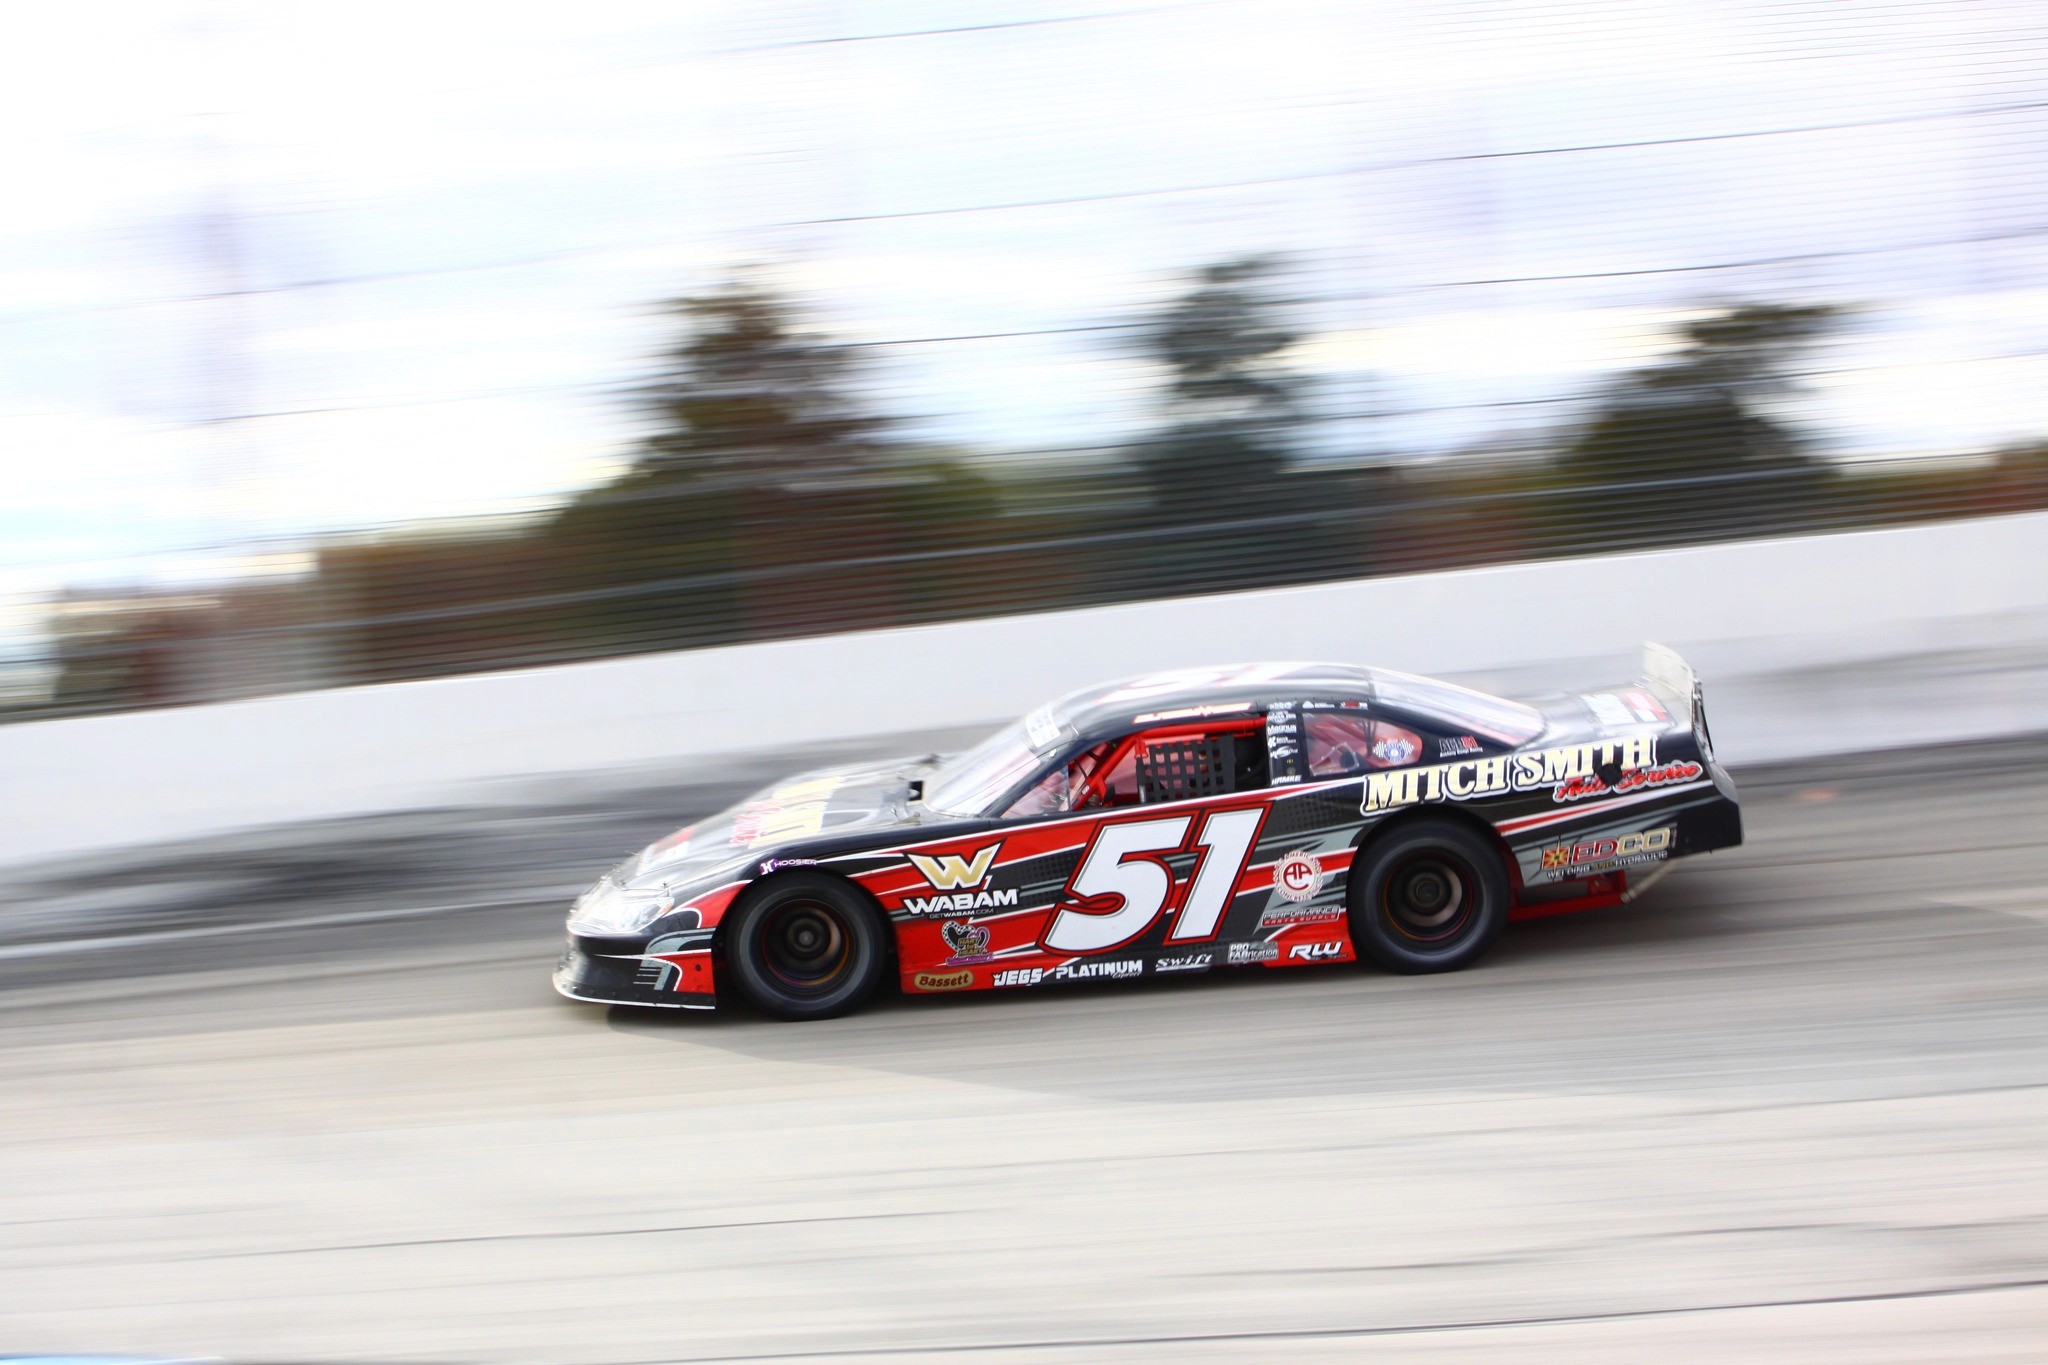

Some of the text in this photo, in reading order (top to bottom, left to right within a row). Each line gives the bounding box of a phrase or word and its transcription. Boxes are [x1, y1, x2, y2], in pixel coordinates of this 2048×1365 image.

[1363, 737, 1656, 813] MITCH SMITH
[774, 858, 817, 868] HOOSIER
[1040, 804, 1268, 953] 51
[903, 888, 1018, 914] WABAM
[1264, 905, 1339, 919] PERFORMANCE
[994, 967, 1044, 986] JEGS
[1056, 959, 1143, 979] PLATINUM
[918, 973, 969, 987] Bassett
